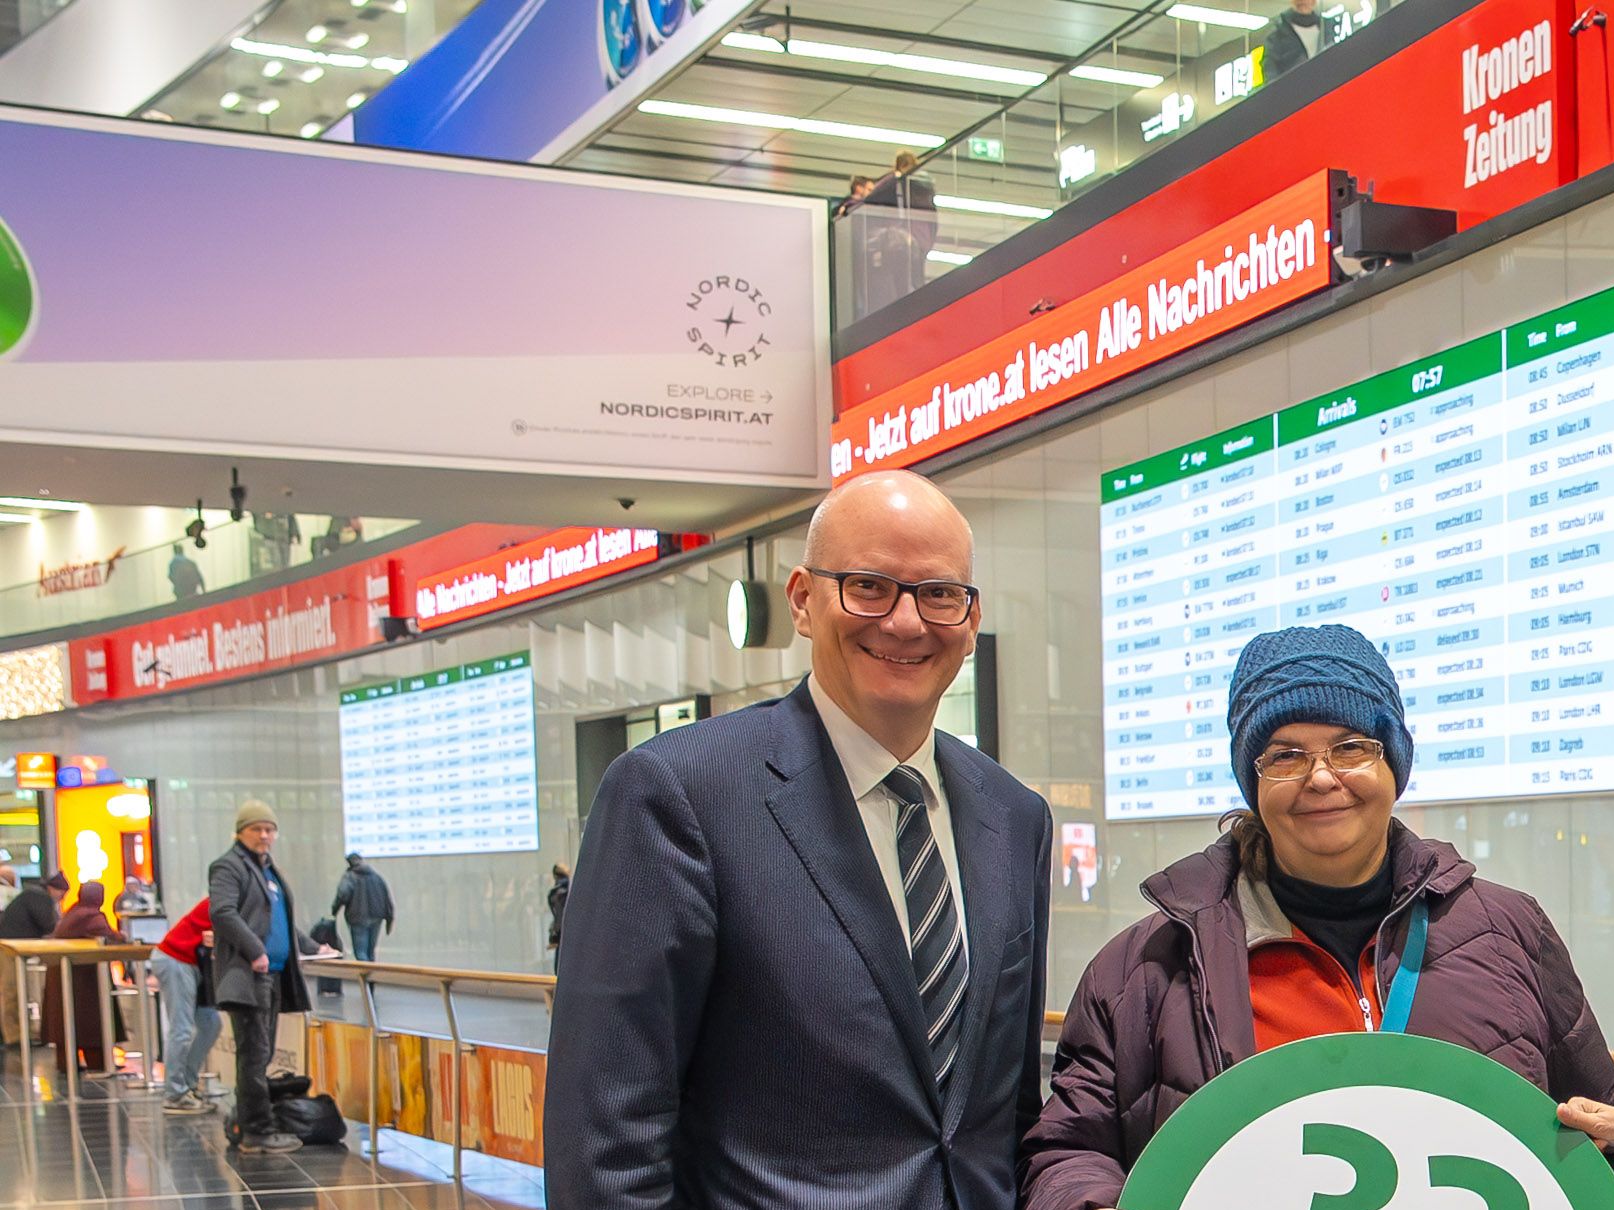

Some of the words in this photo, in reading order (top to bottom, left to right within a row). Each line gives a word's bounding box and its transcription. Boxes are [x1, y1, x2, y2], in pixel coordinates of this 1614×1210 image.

[1462, 20, 1552, 115] Kronen
[1463, 100, 1552, 189] Zeitung
[686, 276, 772, 317] NORDIC
[687, 327, 771, 368] SPIRIT
[864, 405, 908, 465] Jetzt
[910, 384, 943, 439] auf
[943, 349, 1025, 428] krone.at
[1028, 328, 1090, 393] lesen
[1095, 306, 1142, 365] Alle
[1147, 217, 1315, 334] Nachrichten
[1556, 351, 1601, 374] Copenhagen
[666, 384, 755, 403] EXPLORE
[1317, 396, 1357, 426] Arrivals
[1412, 365, 1443, 393] 07:57
[600, 402, 774, 425] NORDICSPIRIT.AT
[1557, 450, 1594, 468] Stockholm
[1557, 481, 1599, 499] Amsterdam
[1557, 610, 1592, 625] Hamburg
